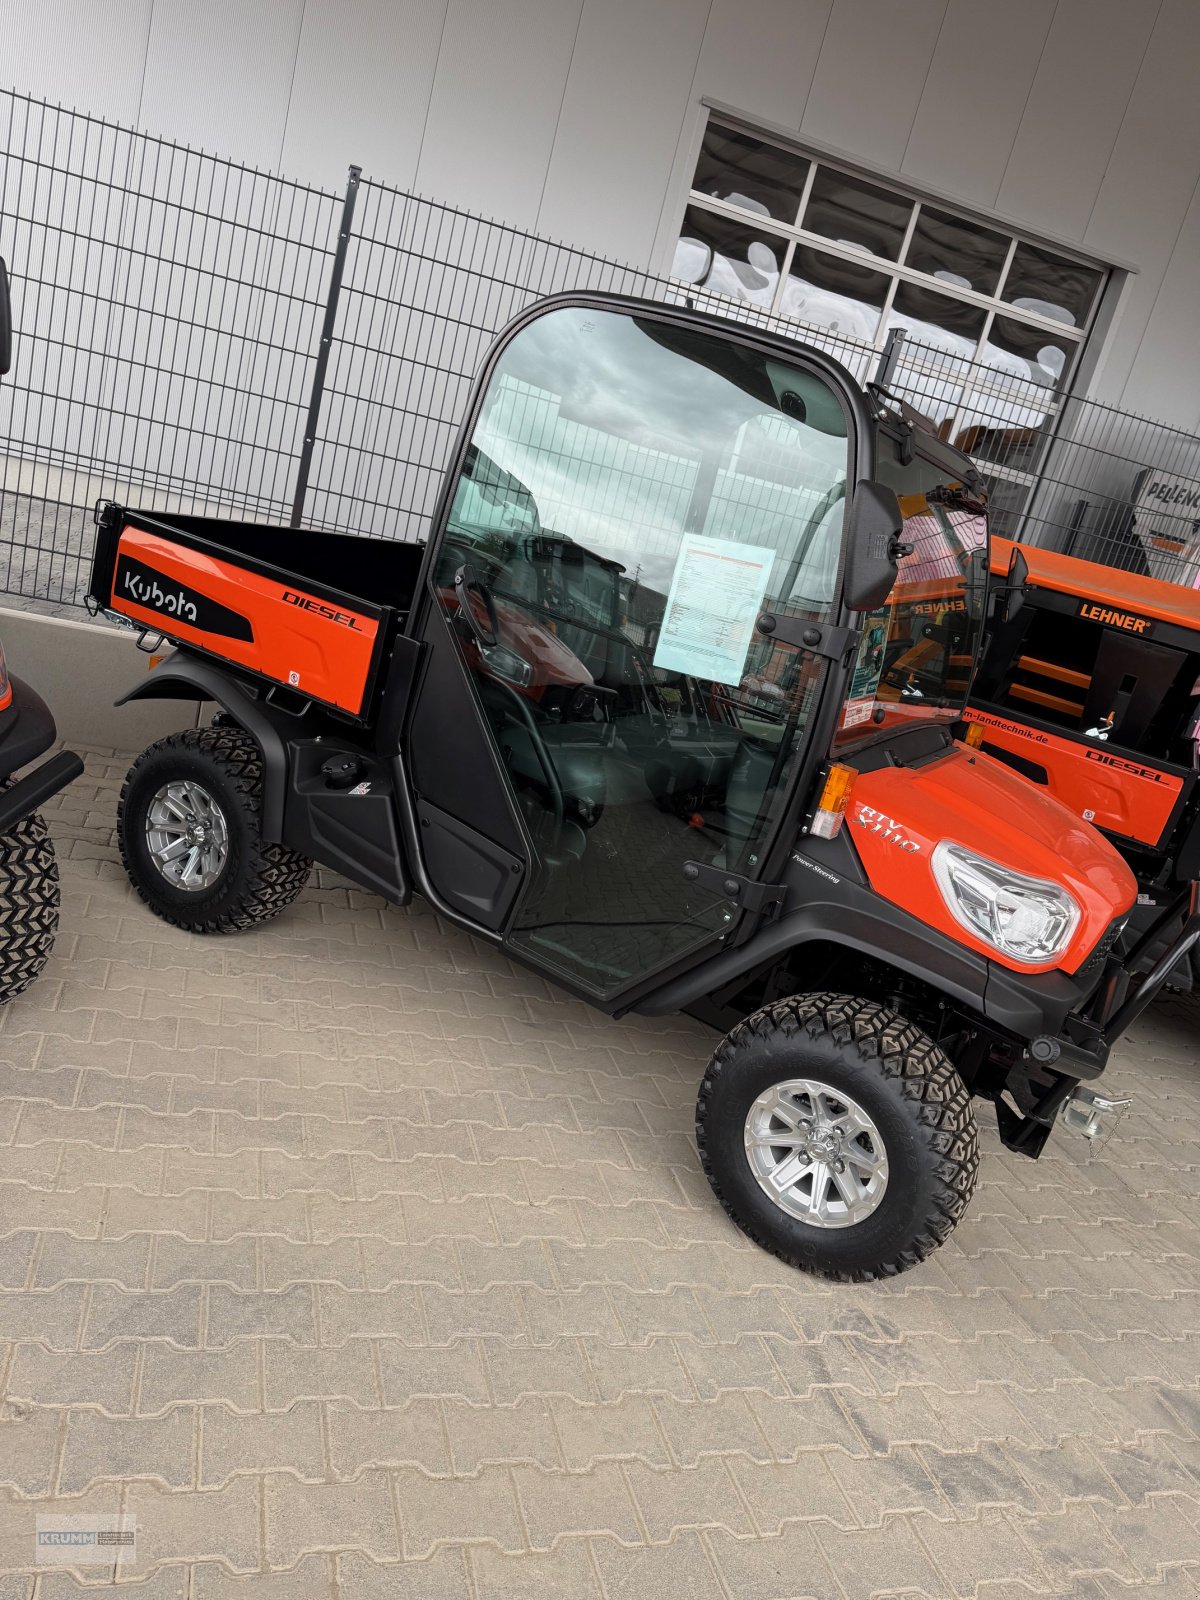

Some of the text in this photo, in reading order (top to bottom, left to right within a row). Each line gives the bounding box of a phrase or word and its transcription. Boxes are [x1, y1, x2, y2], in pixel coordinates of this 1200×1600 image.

[124, 570, 198, 622] Kubota
[281, 591, 363, 631] DIESEL
[1085, 750, 1170, 786] DIESEL
[852, 814, 921, 854] X1110
[860, 805, 904, 830] RTV
[791, 854, 841, 884] Power Steering
